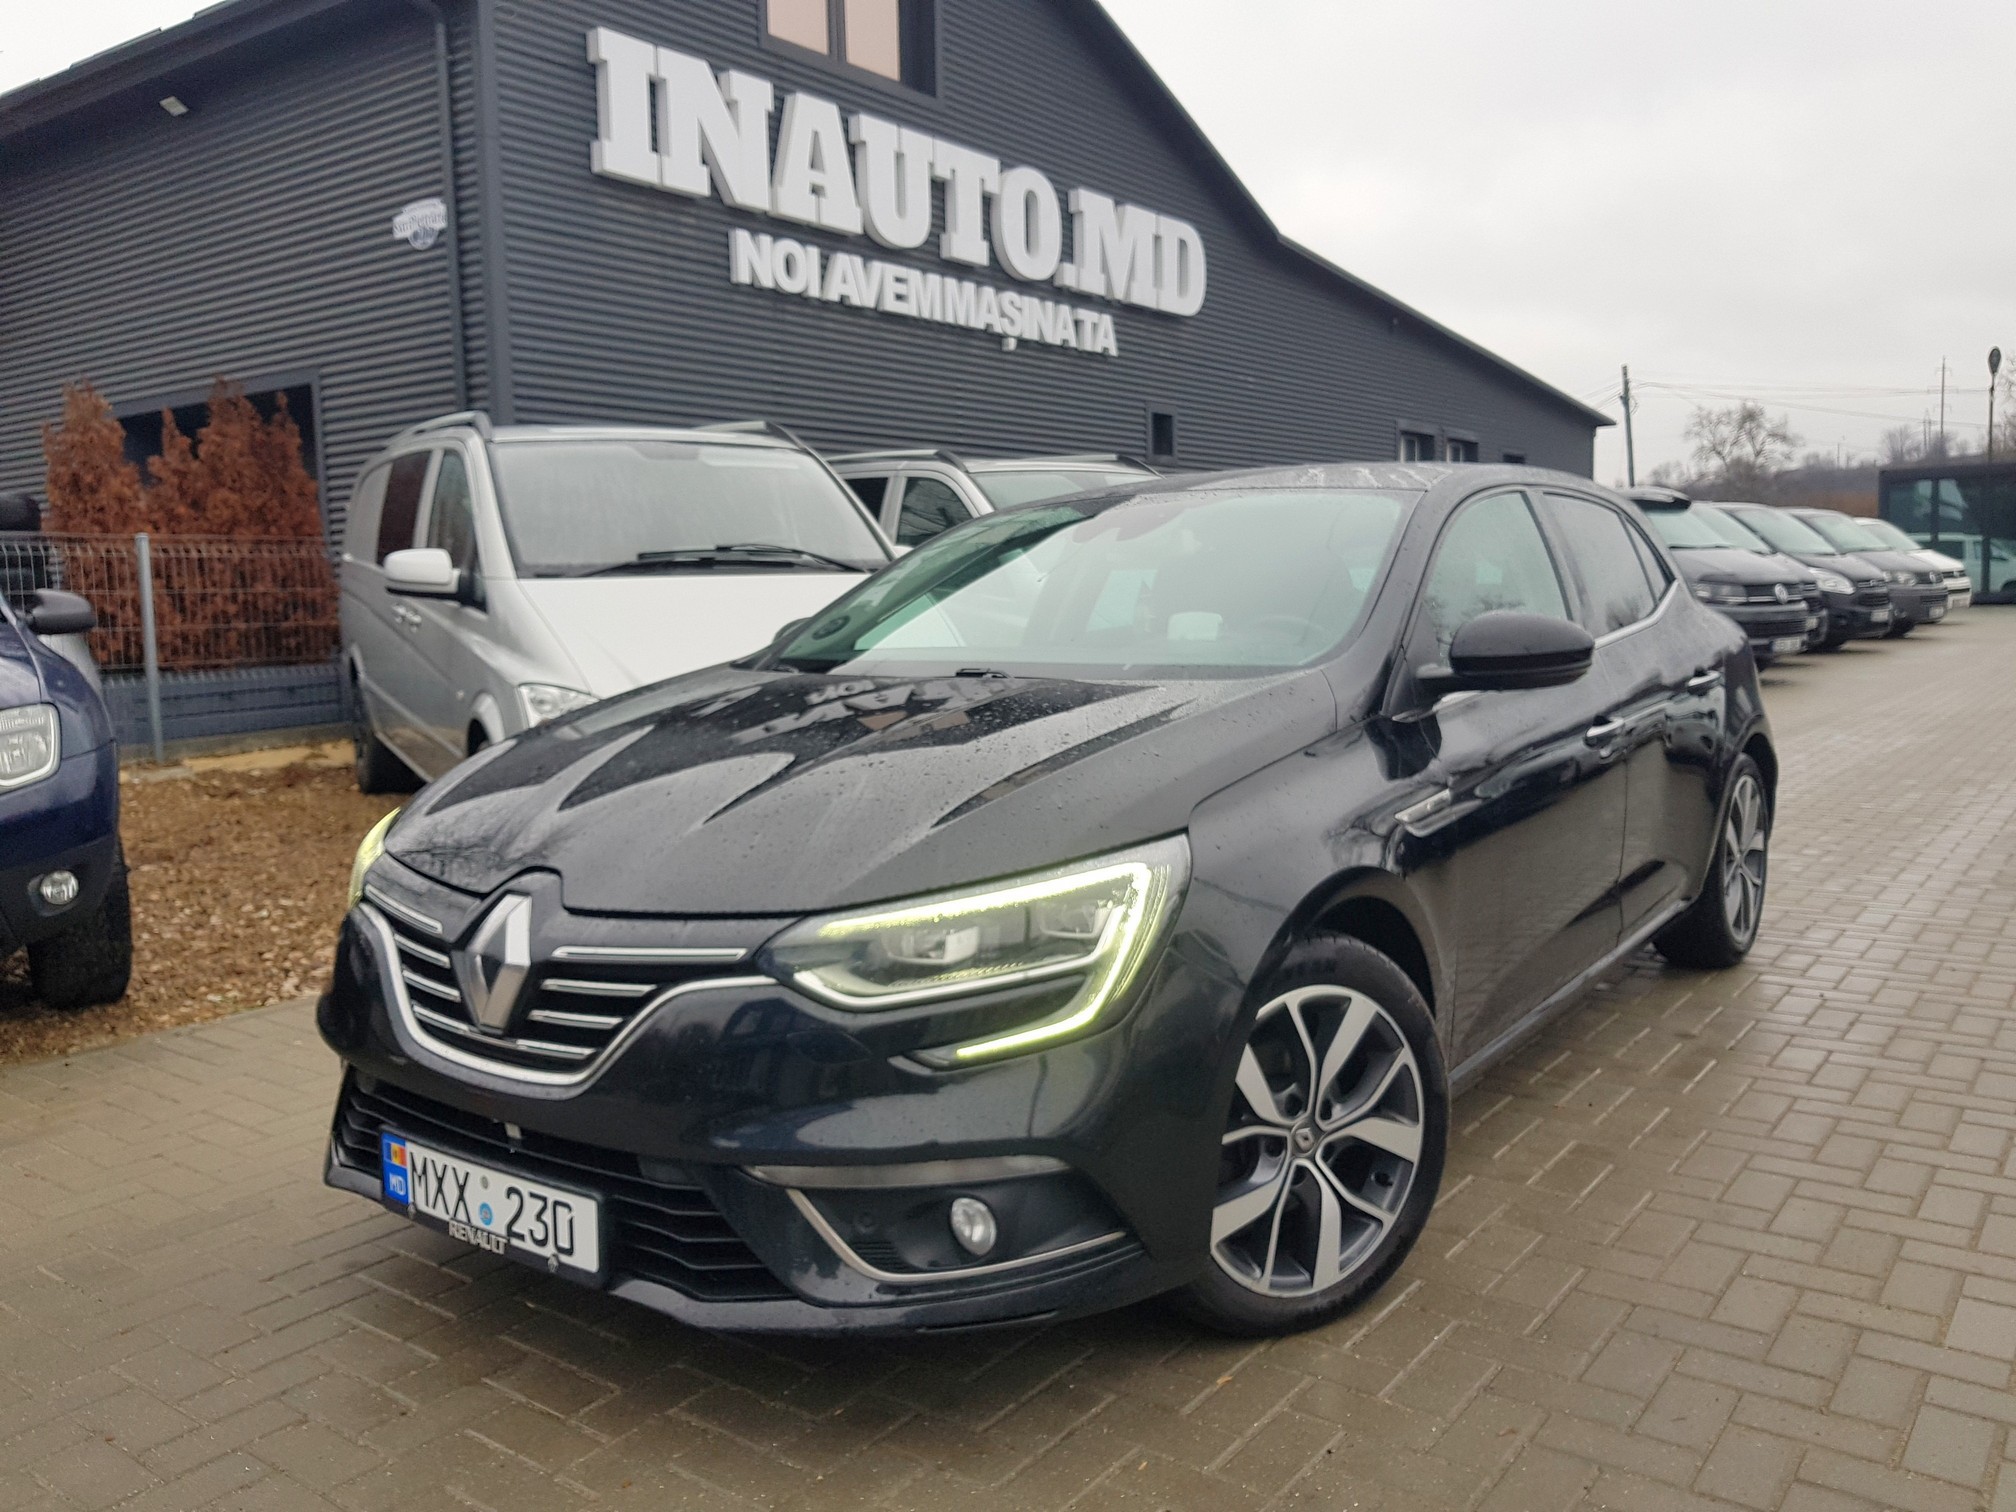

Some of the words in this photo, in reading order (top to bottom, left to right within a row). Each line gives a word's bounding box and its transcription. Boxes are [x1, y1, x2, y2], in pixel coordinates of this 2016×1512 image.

[586, 26, 1207, 317] INAUTO.MD
[728, 227, 821, 299] NOI
[409, 1151, 472, 1224] MXX
[504, 1186, 575, 1257] 230
